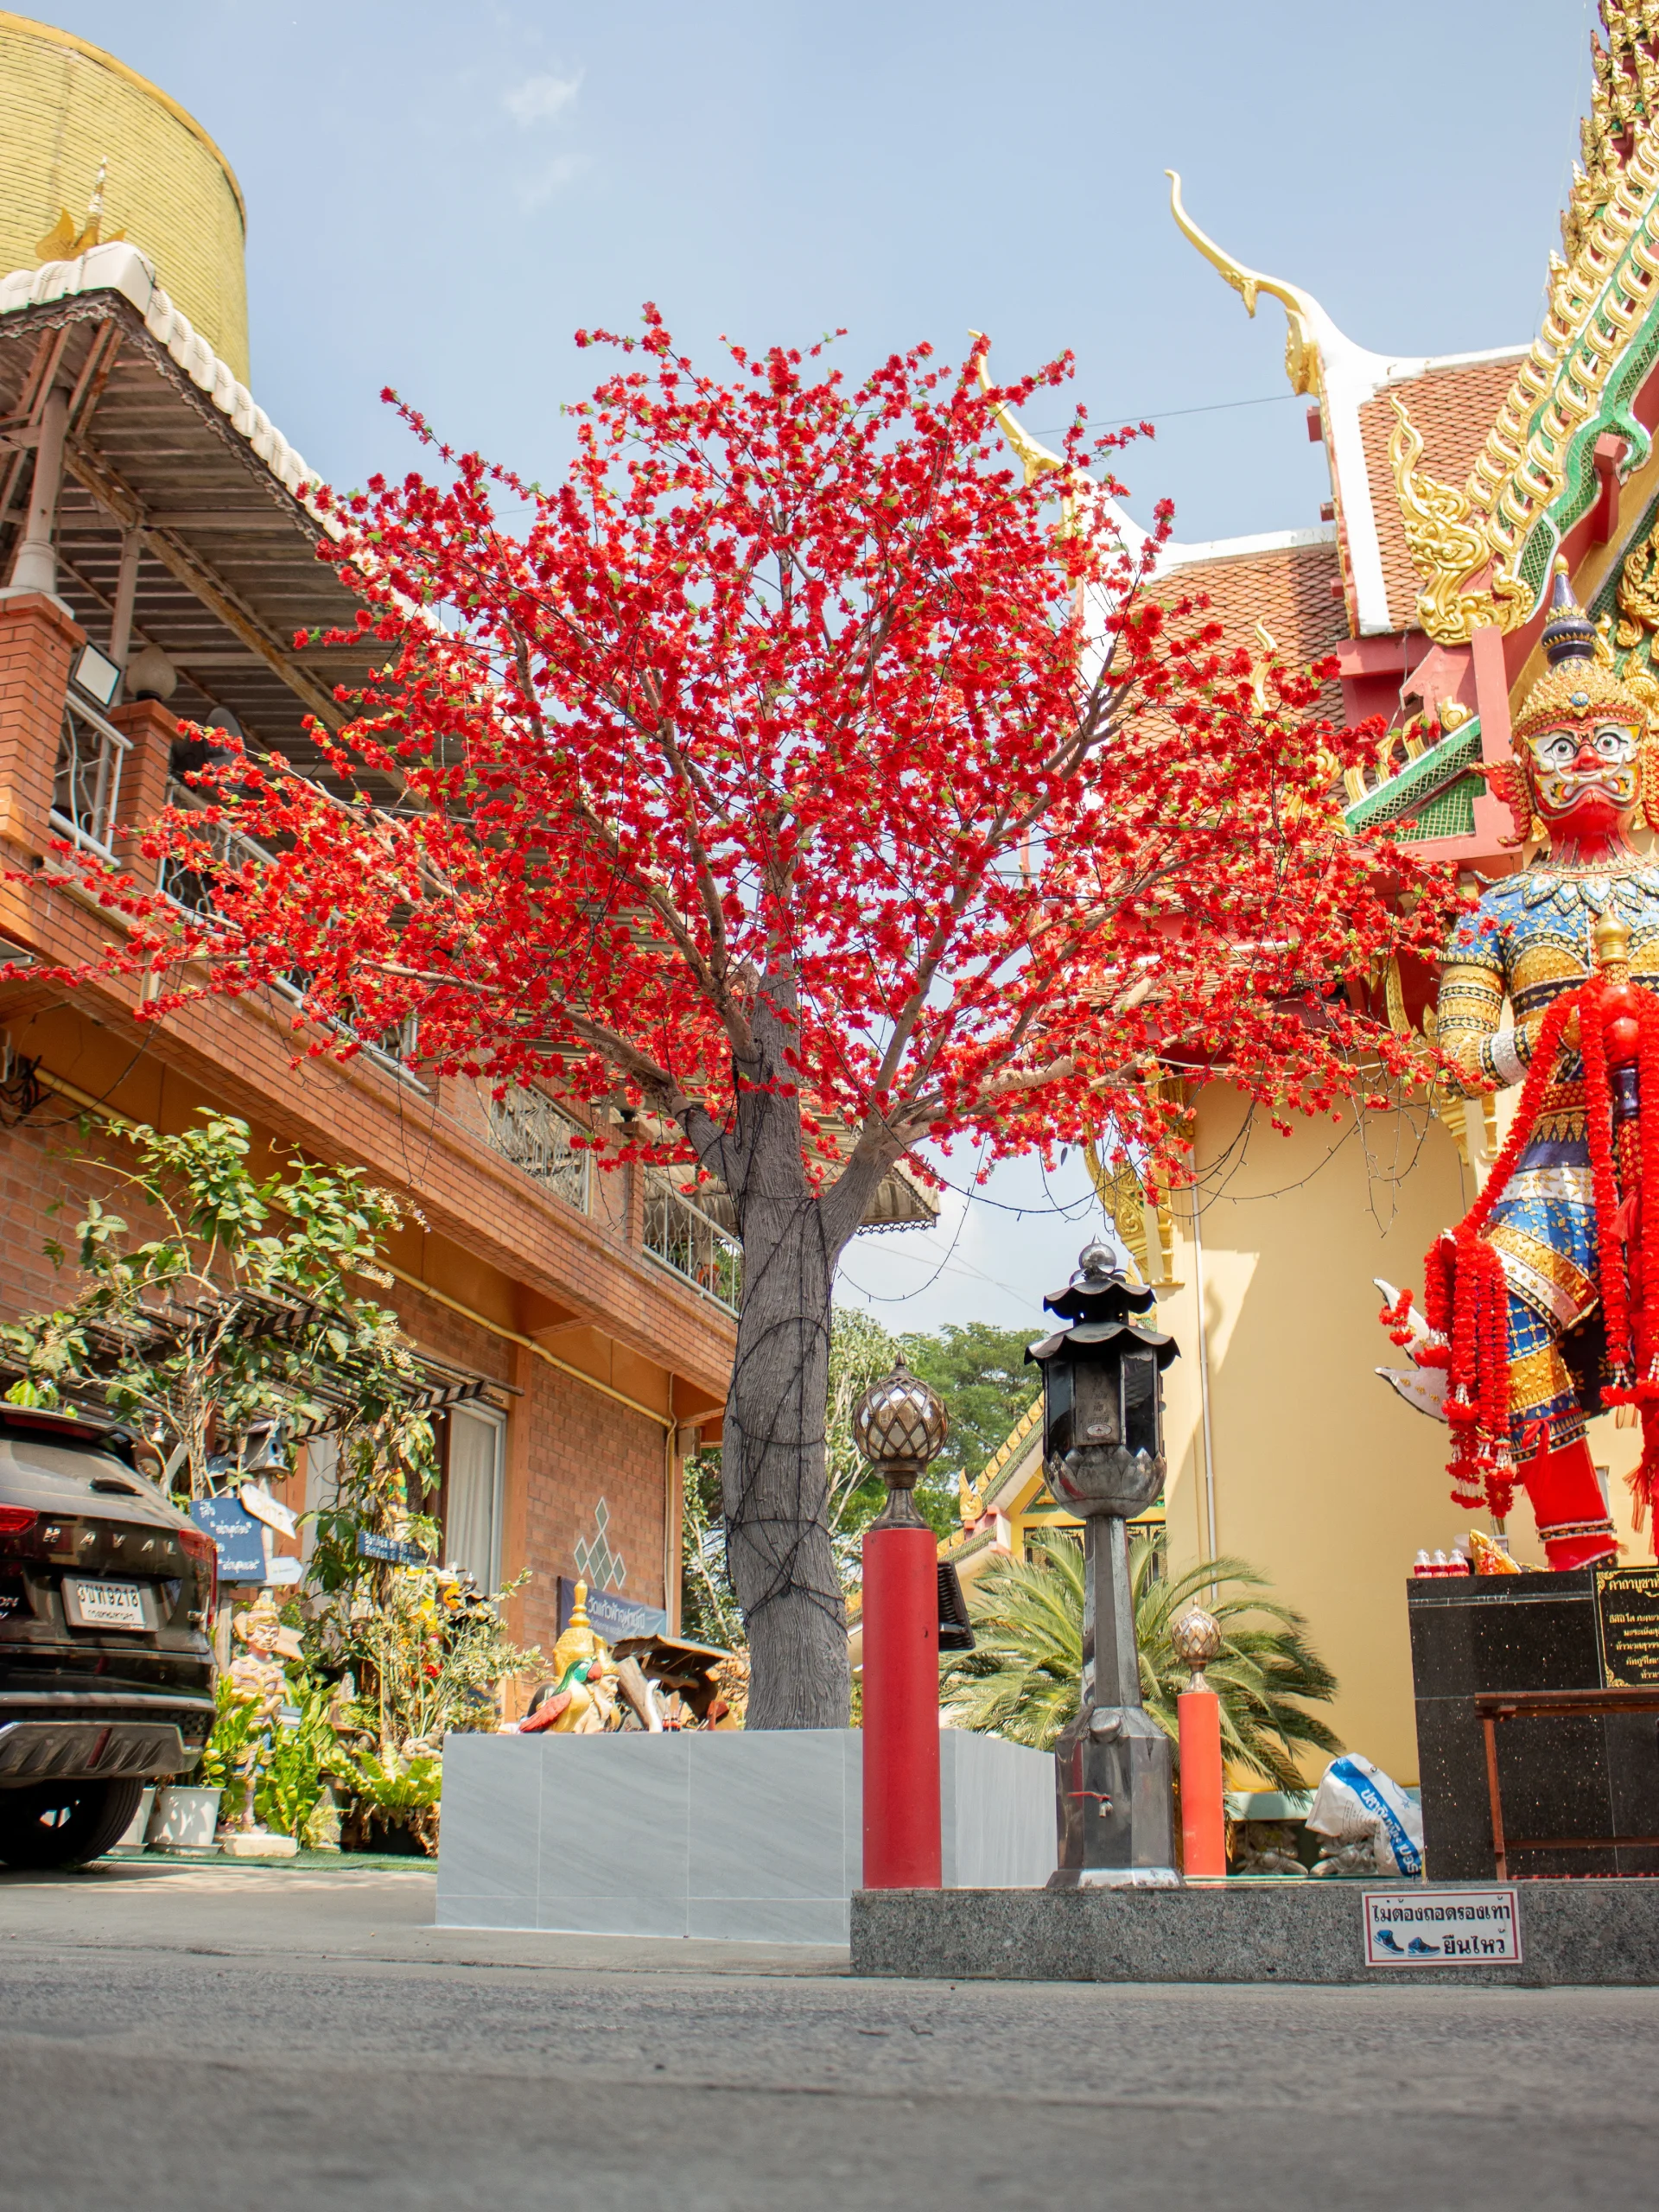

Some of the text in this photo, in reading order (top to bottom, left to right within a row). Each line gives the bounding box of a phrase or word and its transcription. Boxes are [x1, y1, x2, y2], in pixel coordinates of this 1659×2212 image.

[44, 1527, 177, 1555] HAVAL
[1371, 1895, 1510, 1923] ไม่ต้องถอดรองเท้า
[1442, 1928, 1505, 1955] ยืนไหว้
